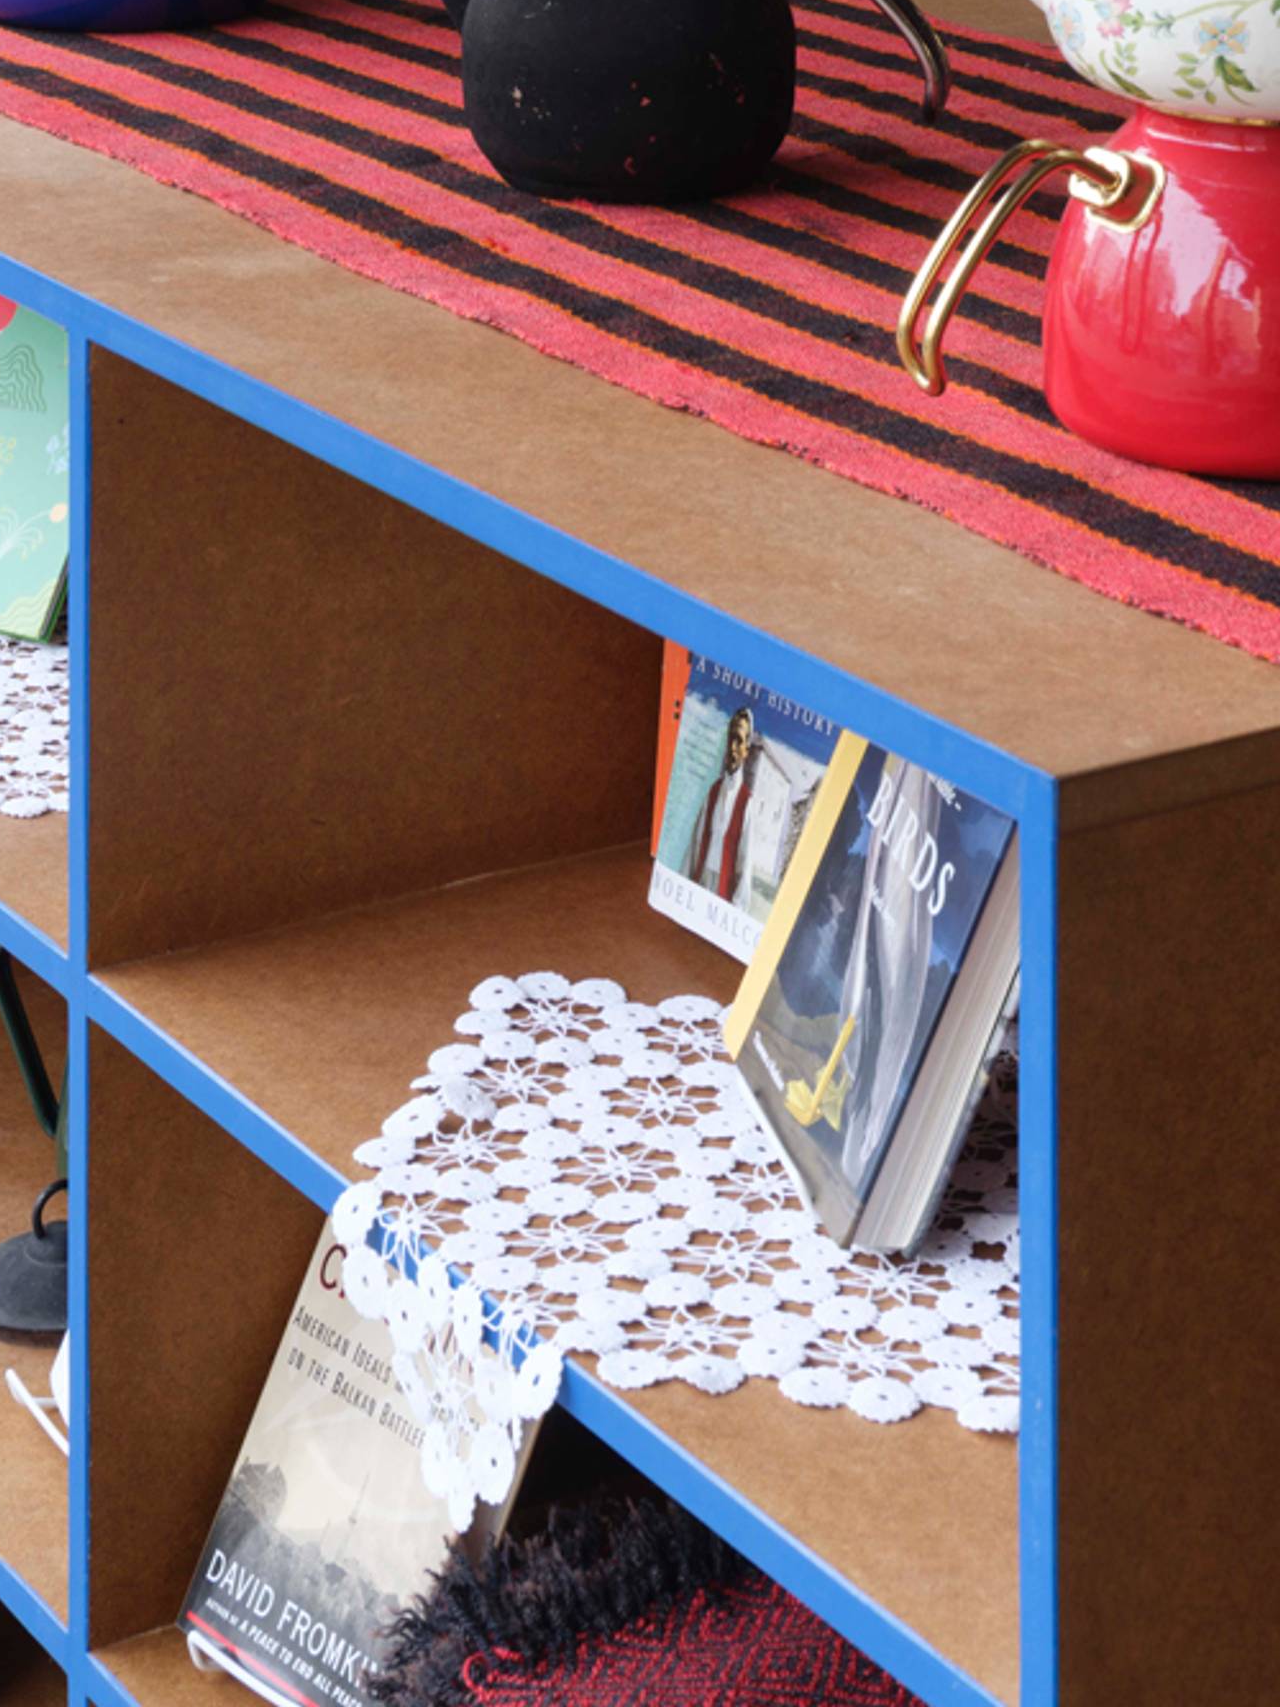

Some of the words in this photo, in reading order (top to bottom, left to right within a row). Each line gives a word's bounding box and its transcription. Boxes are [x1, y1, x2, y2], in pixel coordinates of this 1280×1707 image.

[695, 655, 707, 673] A
[711, 662, 762, 700] SHORT
[767, 690, 835, 737] HISTORY
[866, 771, 956, 917] BIRDS
[286, 1347, 304, 1371] ON
[308, 1358, 331, 1387] THE
[331, 1371, 377, 1418] BALKAN
[292, 1305, 354, 1359] AMERICAN
[352, 1342, 394, 1386] IDEALS
[205, 1548, 276, 1619] DAVID
[238, 1619, 250, 1634] A
[247, 1624, 281, 1656] PEACE
[278, 1646, 294, 1665] TO
[291, 1658, 315, 1680] END
[312, 1671, 335, 1695] ALL
